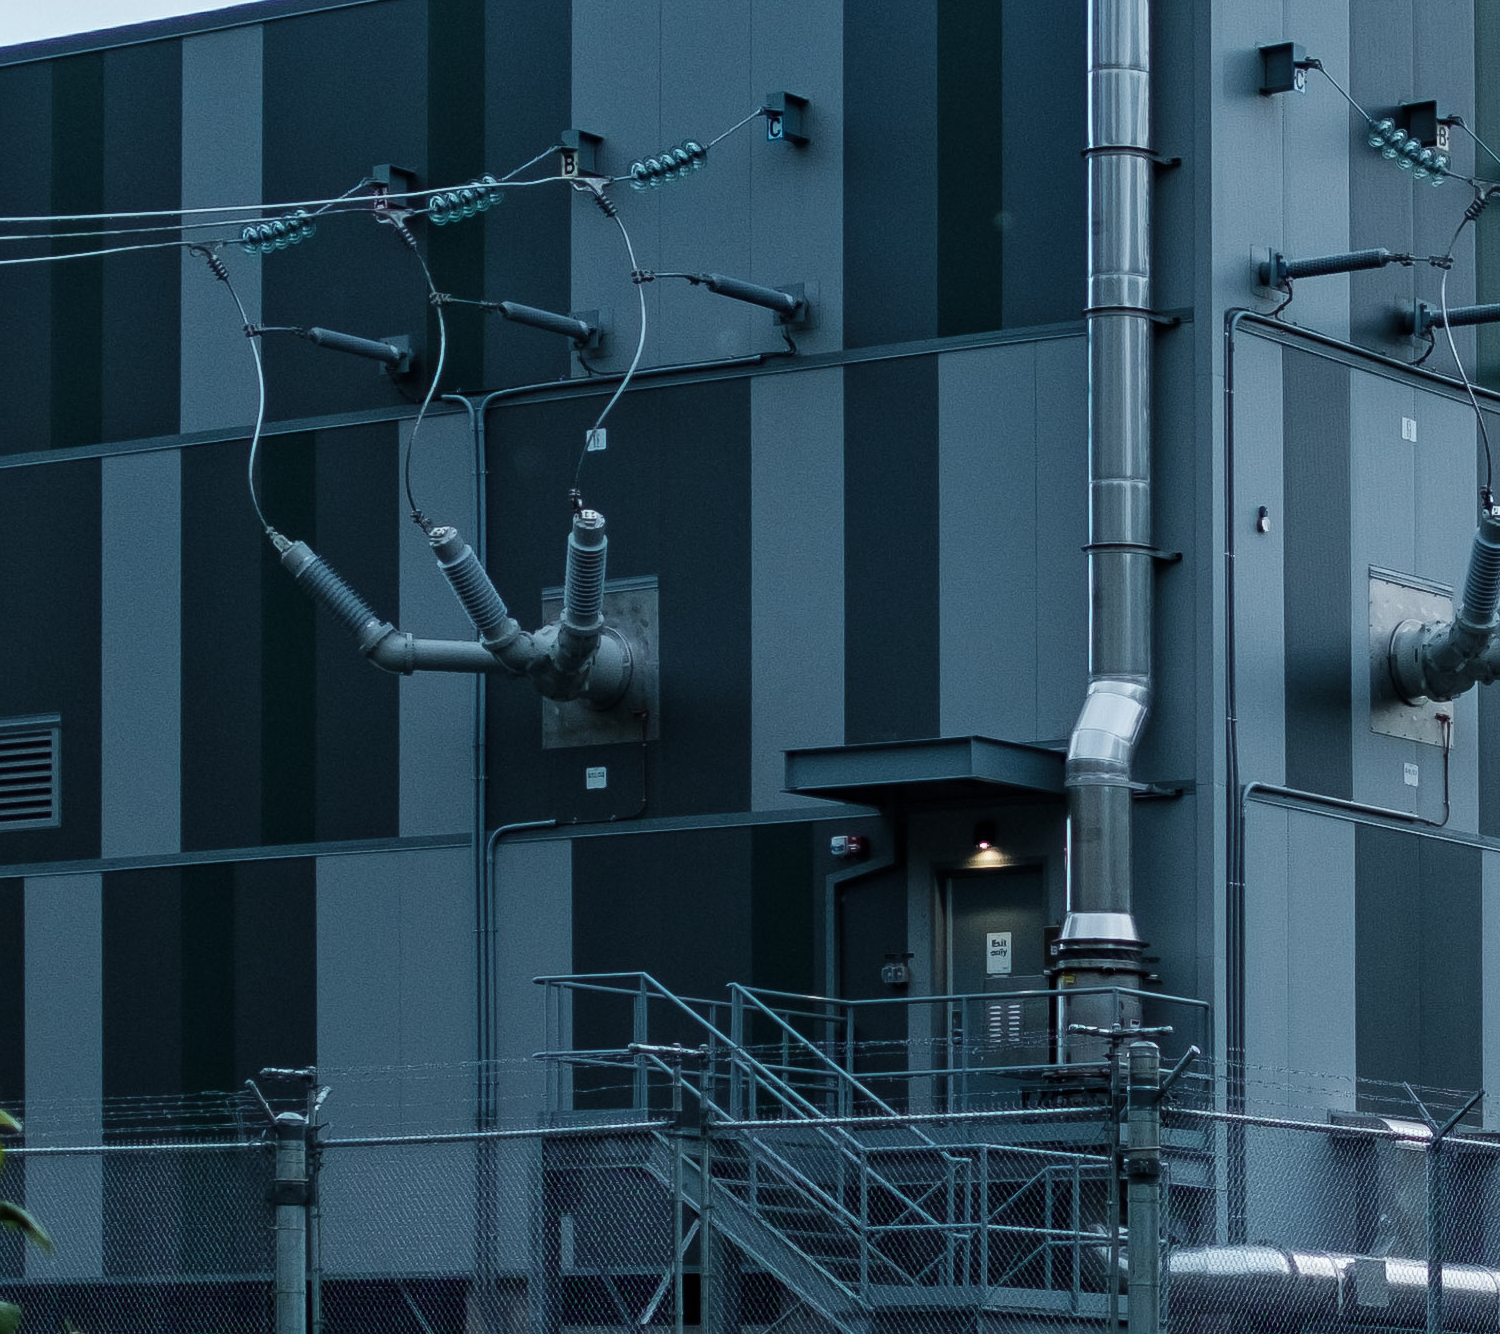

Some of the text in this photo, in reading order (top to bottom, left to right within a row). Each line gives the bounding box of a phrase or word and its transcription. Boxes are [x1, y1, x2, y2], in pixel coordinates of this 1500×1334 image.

[1296, 70, 1304, 90] C
[770, 117, 781, 137] C
[1439, 127, 1446, 146] B
[565, 155, 574, 174] B
